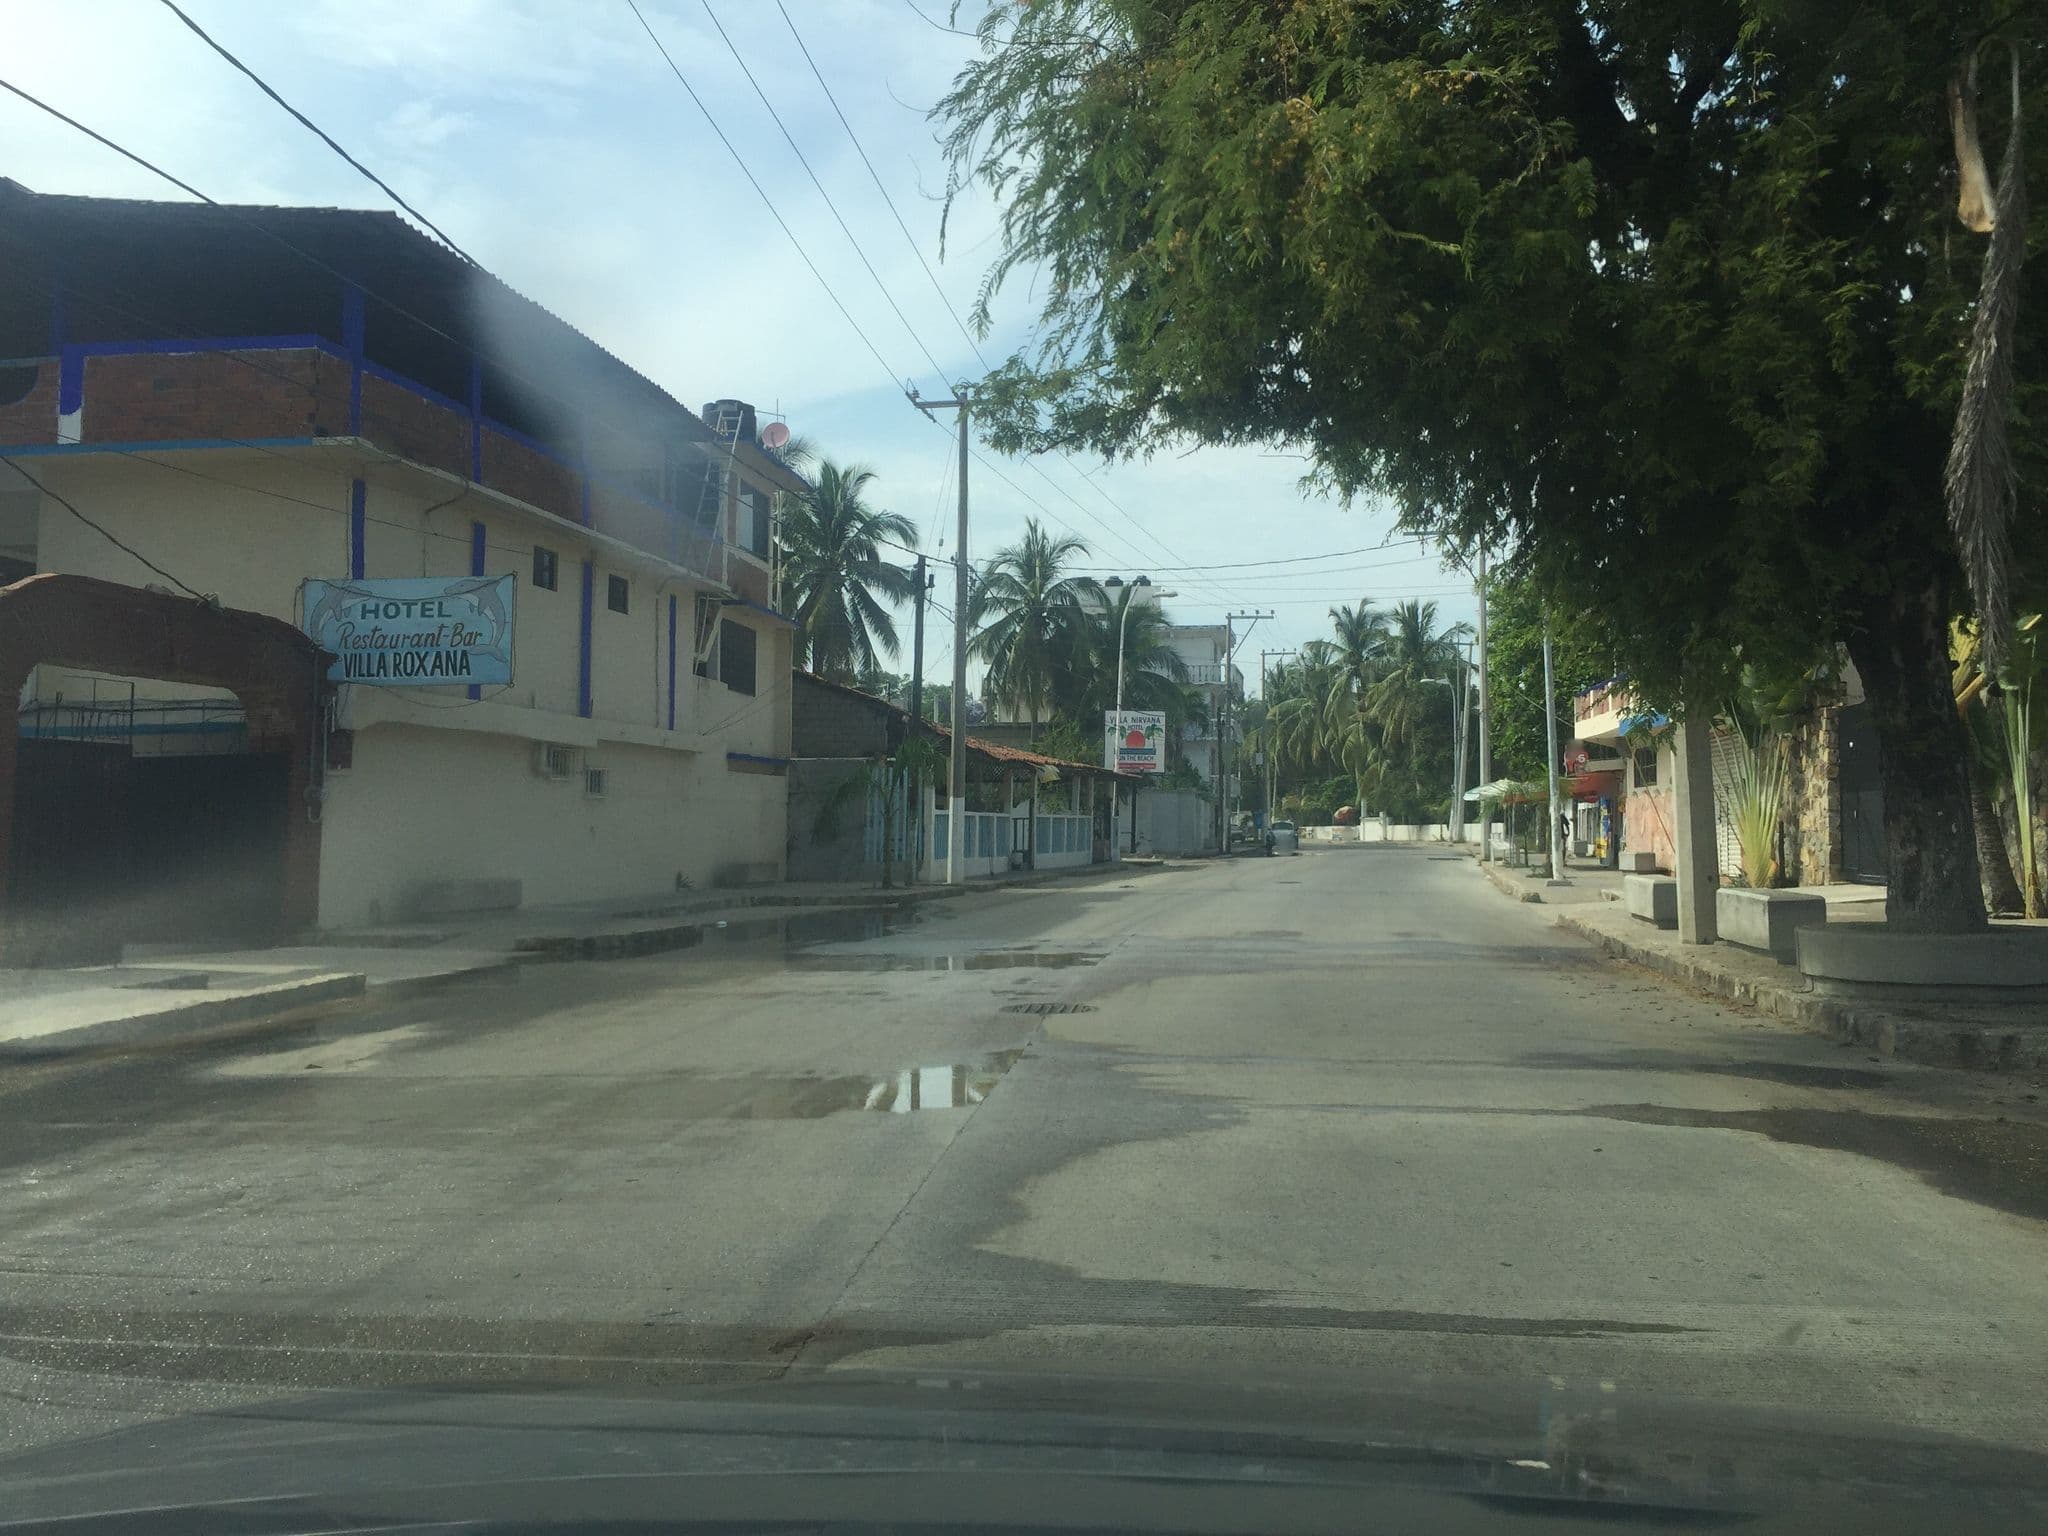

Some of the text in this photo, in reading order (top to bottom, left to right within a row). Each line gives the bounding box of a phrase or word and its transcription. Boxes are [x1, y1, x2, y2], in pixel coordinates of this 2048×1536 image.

[360, 601, 453, 620] HOTEL
[343, 650, 472, 678] VILLA ROXANA
[1109, 716, 1161, 724] VILA NIRVANA
